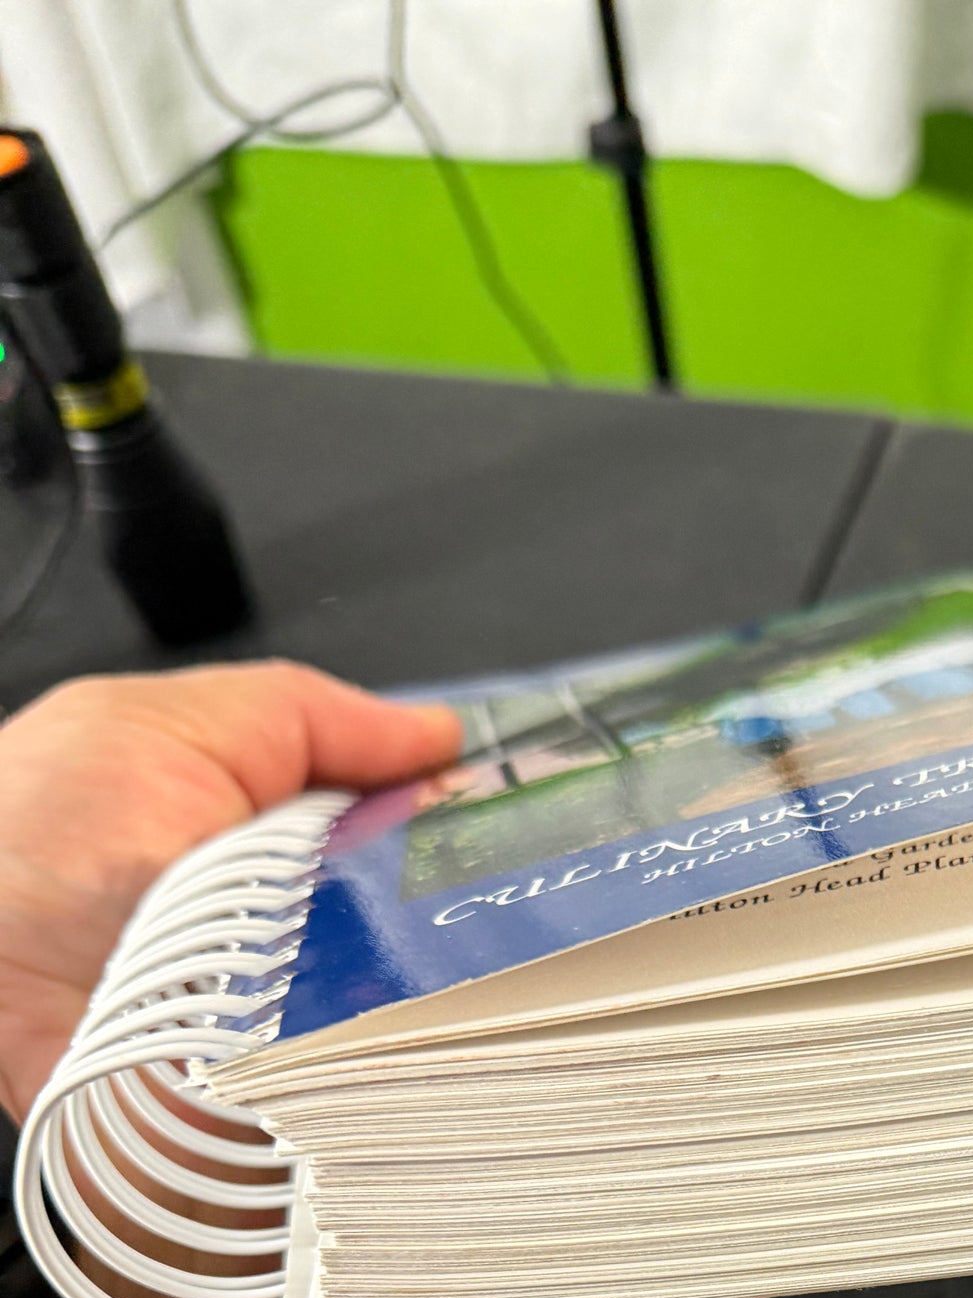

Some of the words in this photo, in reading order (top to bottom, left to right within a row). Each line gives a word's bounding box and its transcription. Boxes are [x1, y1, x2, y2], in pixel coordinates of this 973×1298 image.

[432, 784, 875, 926] CULINARY
[641, 818, 841, 884] HILTON
[789, 866, 892, 898] Head
